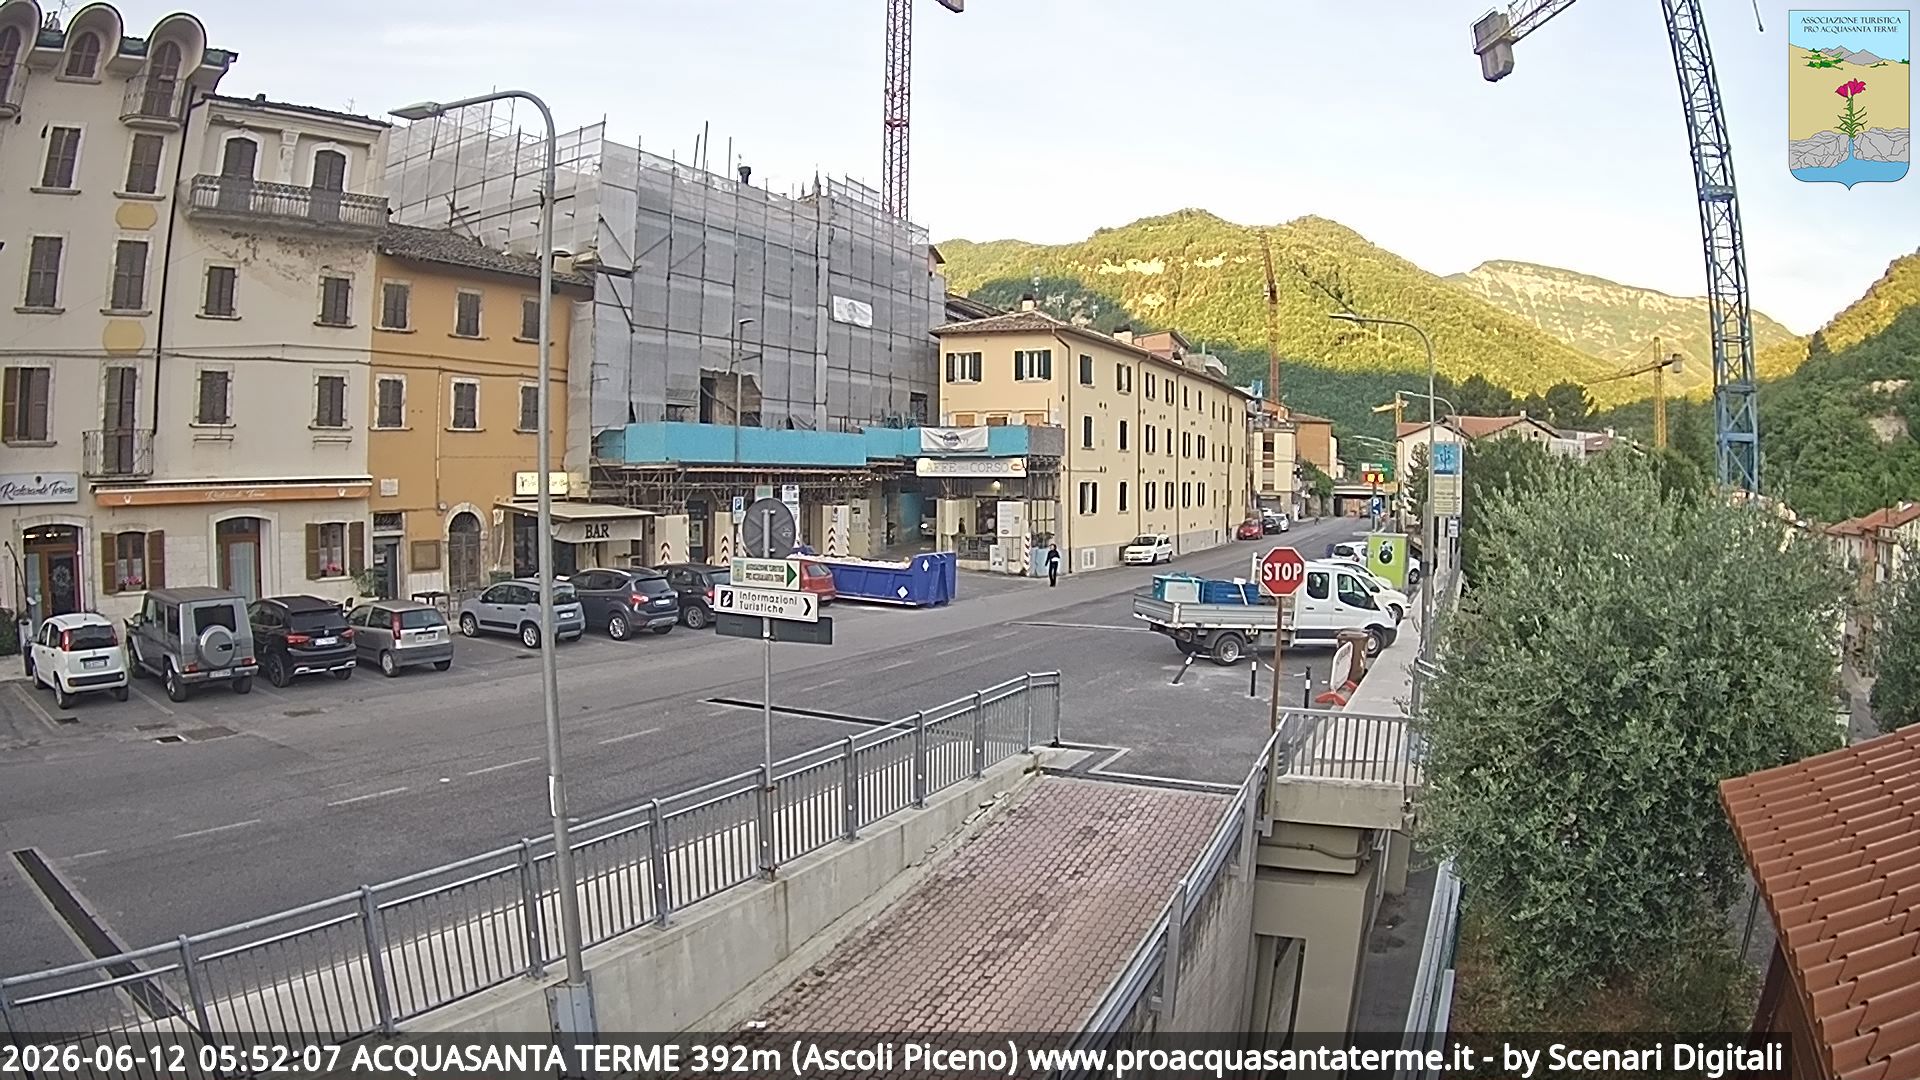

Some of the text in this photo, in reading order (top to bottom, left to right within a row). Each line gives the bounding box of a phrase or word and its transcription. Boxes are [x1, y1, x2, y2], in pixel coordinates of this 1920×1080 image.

[970, 462, 1009, 473] CORSO
[585, 524, 610, 539] BAR
[1263, 562, 1302, 581] STOP
[740, 591, 797, 605] Informazioni
[740, 600, 784, 614] Turistiche
